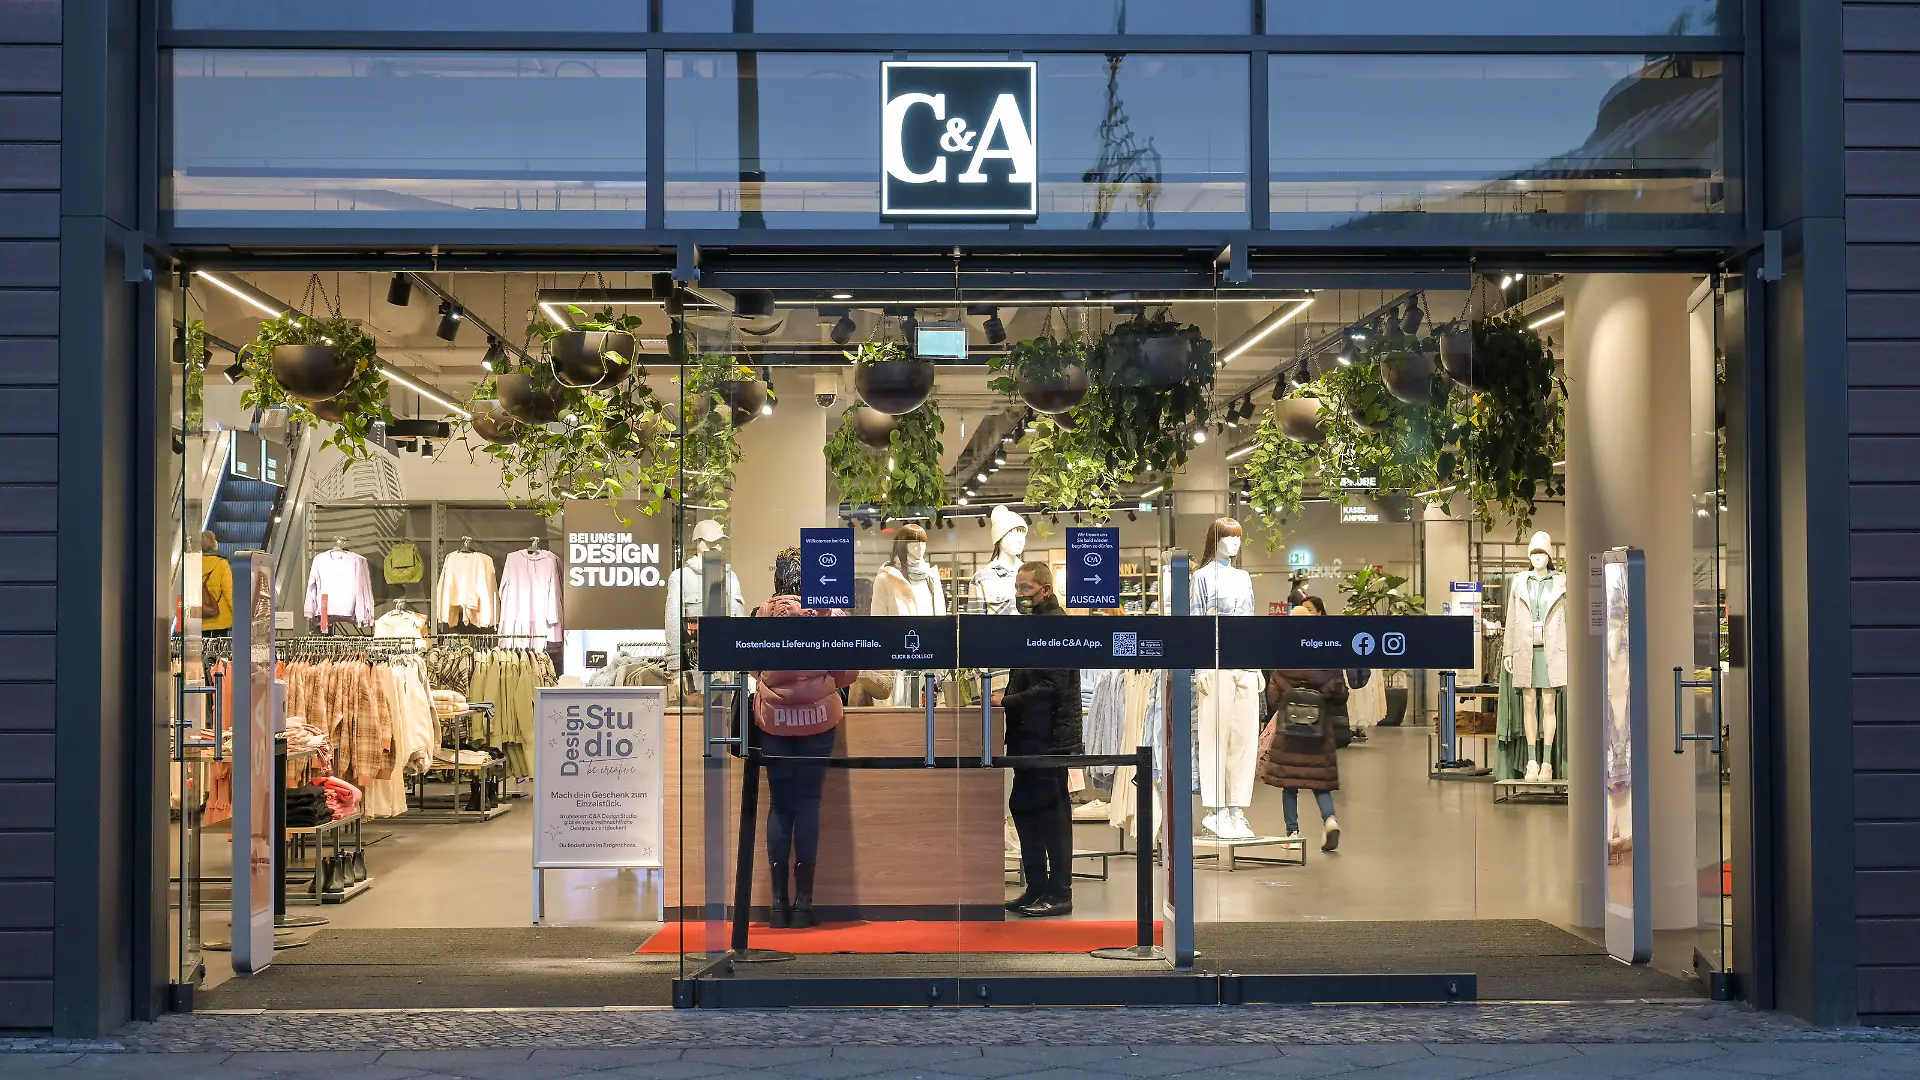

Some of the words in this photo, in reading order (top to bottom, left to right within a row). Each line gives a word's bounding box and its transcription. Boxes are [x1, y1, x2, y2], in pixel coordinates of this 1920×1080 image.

[884, 92, 1034, 184] C&A
[1343, 506, 1366, 514] KASSE
[1343, 514, 1379, 522] ANPROBE
[569, 532, 588, 543] BEI
[590, 532, 615, 543] UNS
[616, 532, 632, 543] IM
[569, 543, 660, 564] DESIGN
[569, 566, 666, 587] STUDIO.
[807, 596, 849, 605] EINGANG
[1070, 595, 1116, 604] AUSGANG
[1269, 605, 1287, 614] SAL
[735, 640, 781, 649] Kostenlose
[782, 640, 820, 650] Lieferung
[822, 640, 830, 648] in
[831, 640, 854, 648] deine
[855, 640, 882, 648] Filiale.
[1026, 638, 1047, 647] Lade
[1048, 638, 1061, 647] die
[1062, 638, 1082, 647] C&A
[1083, 638, 1103, 648] App.
[1300, 639, 1323, 649] Folge
[585, 704, 633, 730] Stu
[774, 705, 828, 727] PUMA
[560, 705, 585, 777] Design
[584, 731, 634, 757] dio
[551, 791, 572, 799] Mach
[573, 791, 591, 799] dein
[591, 791, 630, 799] Geschenk
[576, 800, 622, 808] Einzelstück.
